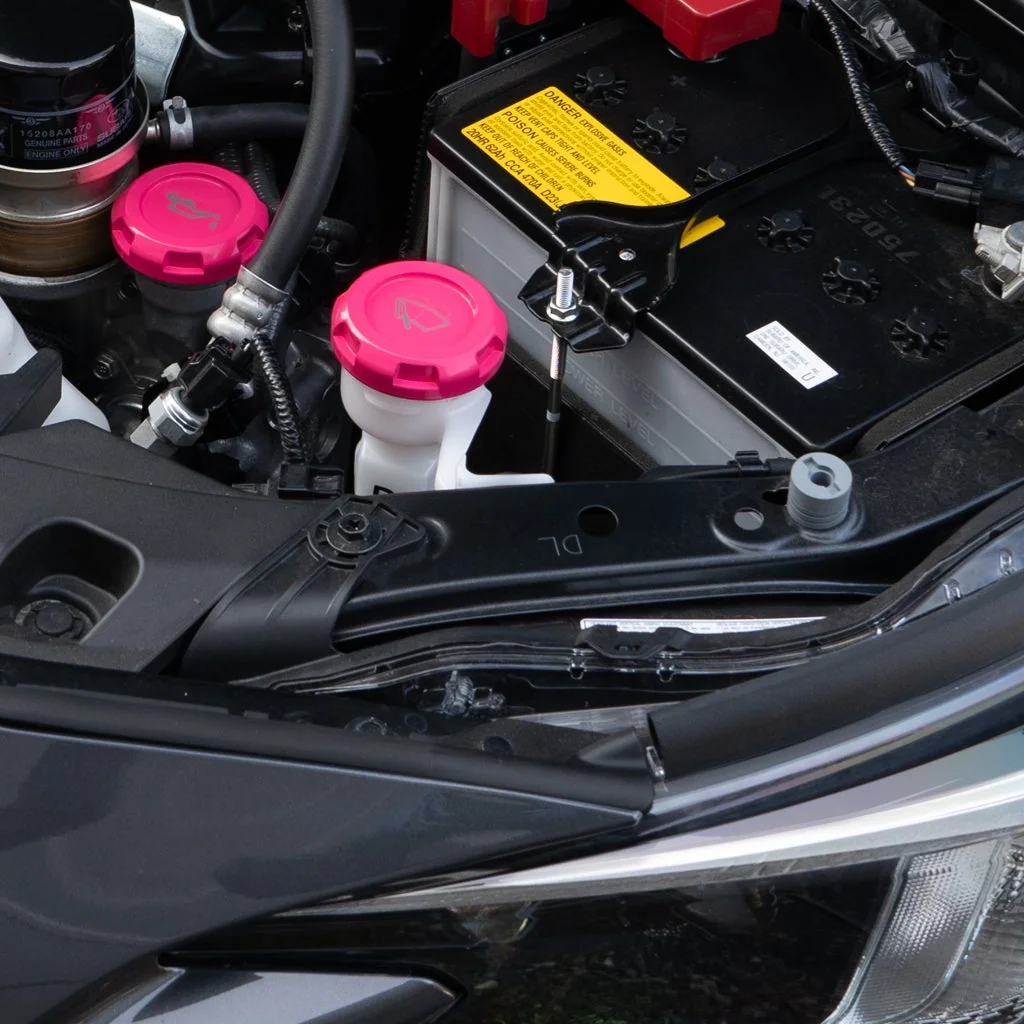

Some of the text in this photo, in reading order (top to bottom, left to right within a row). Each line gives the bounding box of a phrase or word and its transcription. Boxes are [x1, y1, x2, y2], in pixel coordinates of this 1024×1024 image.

[20, 122, 93, 138] 15208AA170
[24, 133, 88, 148] GENUINE PARTS
[26, 143, 87, 160] ENGINE ONLY
[501, 110, 596, 187] POISON CAUSES SEVERE BURNS
[513, 104, 601, 174] KEEP VENT CAPS TIGHT AND LEVEL
[542, 90, 627, 156] DANGER EXPLOSIVE GASES
[465, 127, 491, 145] 20HR
[483, 142, 508, 160] 62Ah
[502, 158, 526, 175] CCA
[519, 172, 543, 190] 470A
[478, 122, 564, 192] KEEP OUT OF REACH OF CHILDREN
[801, 371, 816, 382] U
